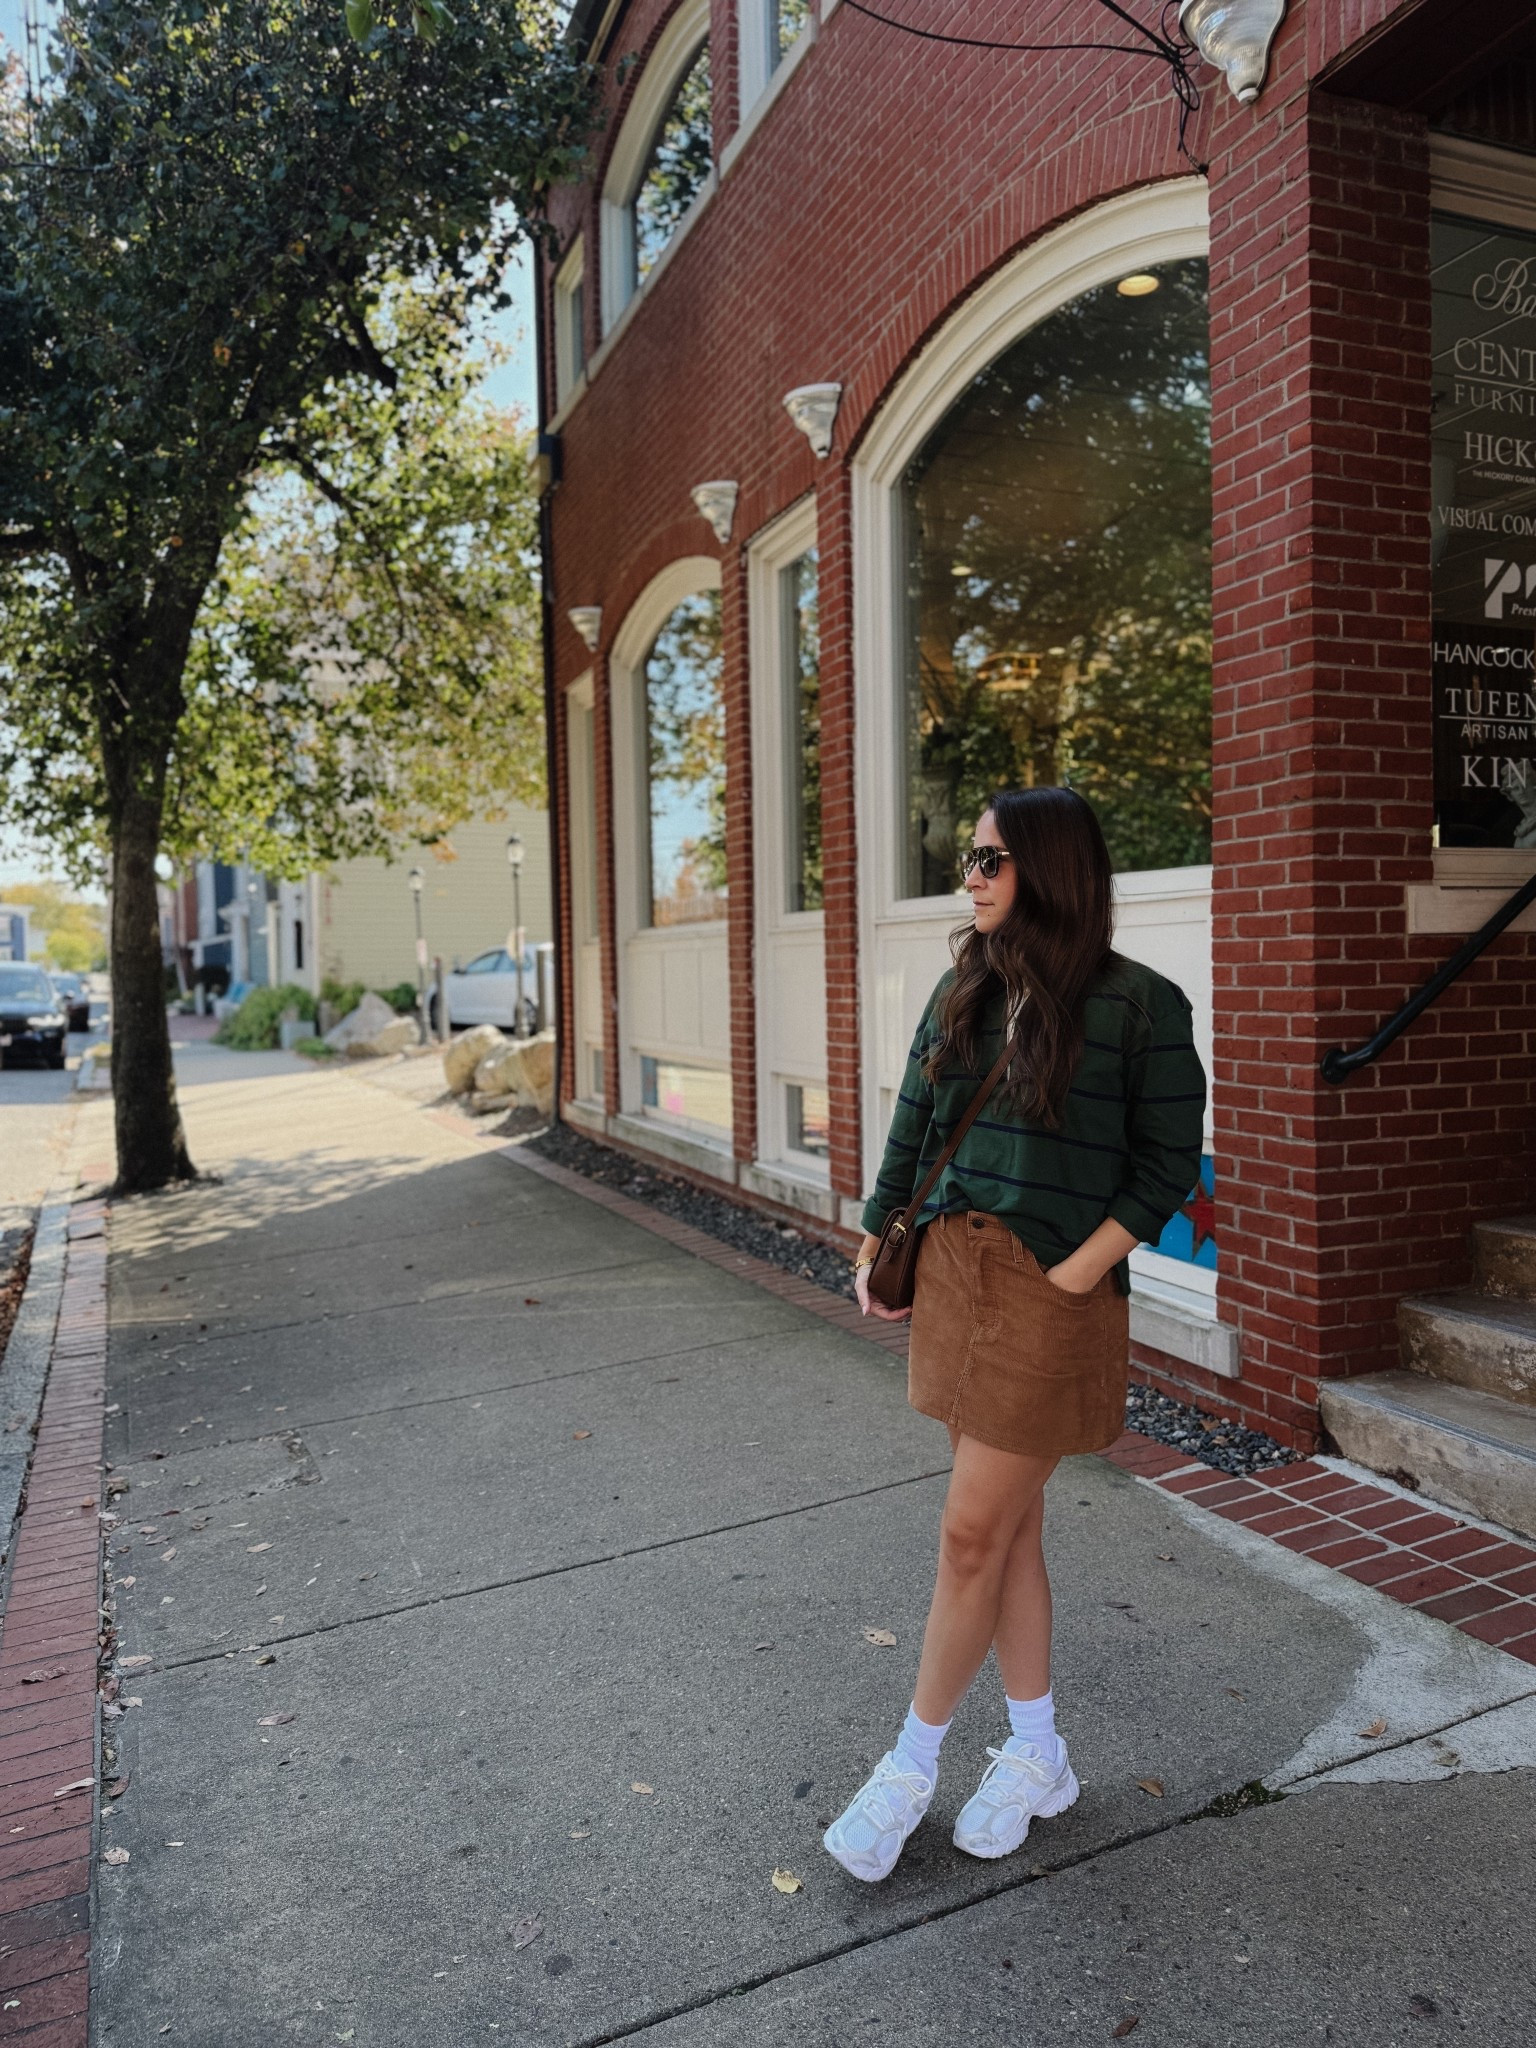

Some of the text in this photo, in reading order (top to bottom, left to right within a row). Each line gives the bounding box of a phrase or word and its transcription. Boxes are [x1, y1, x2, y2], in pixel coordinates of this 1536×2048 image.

[1454, 384, 1536, 416] FURNI
[1464, 430, 1536, 468] HICK
[1484, 471, 1514, 481] HICKORY
[1515, 474, 1536, 484] CHAIR
[1438, 506, 1498, 531] VISUAL
[1433, 641, 1535, 669] HANCOCK
[1461, 724, 1528, 740] ARTISAN
[1462, 755, 1536, 789] KIN
